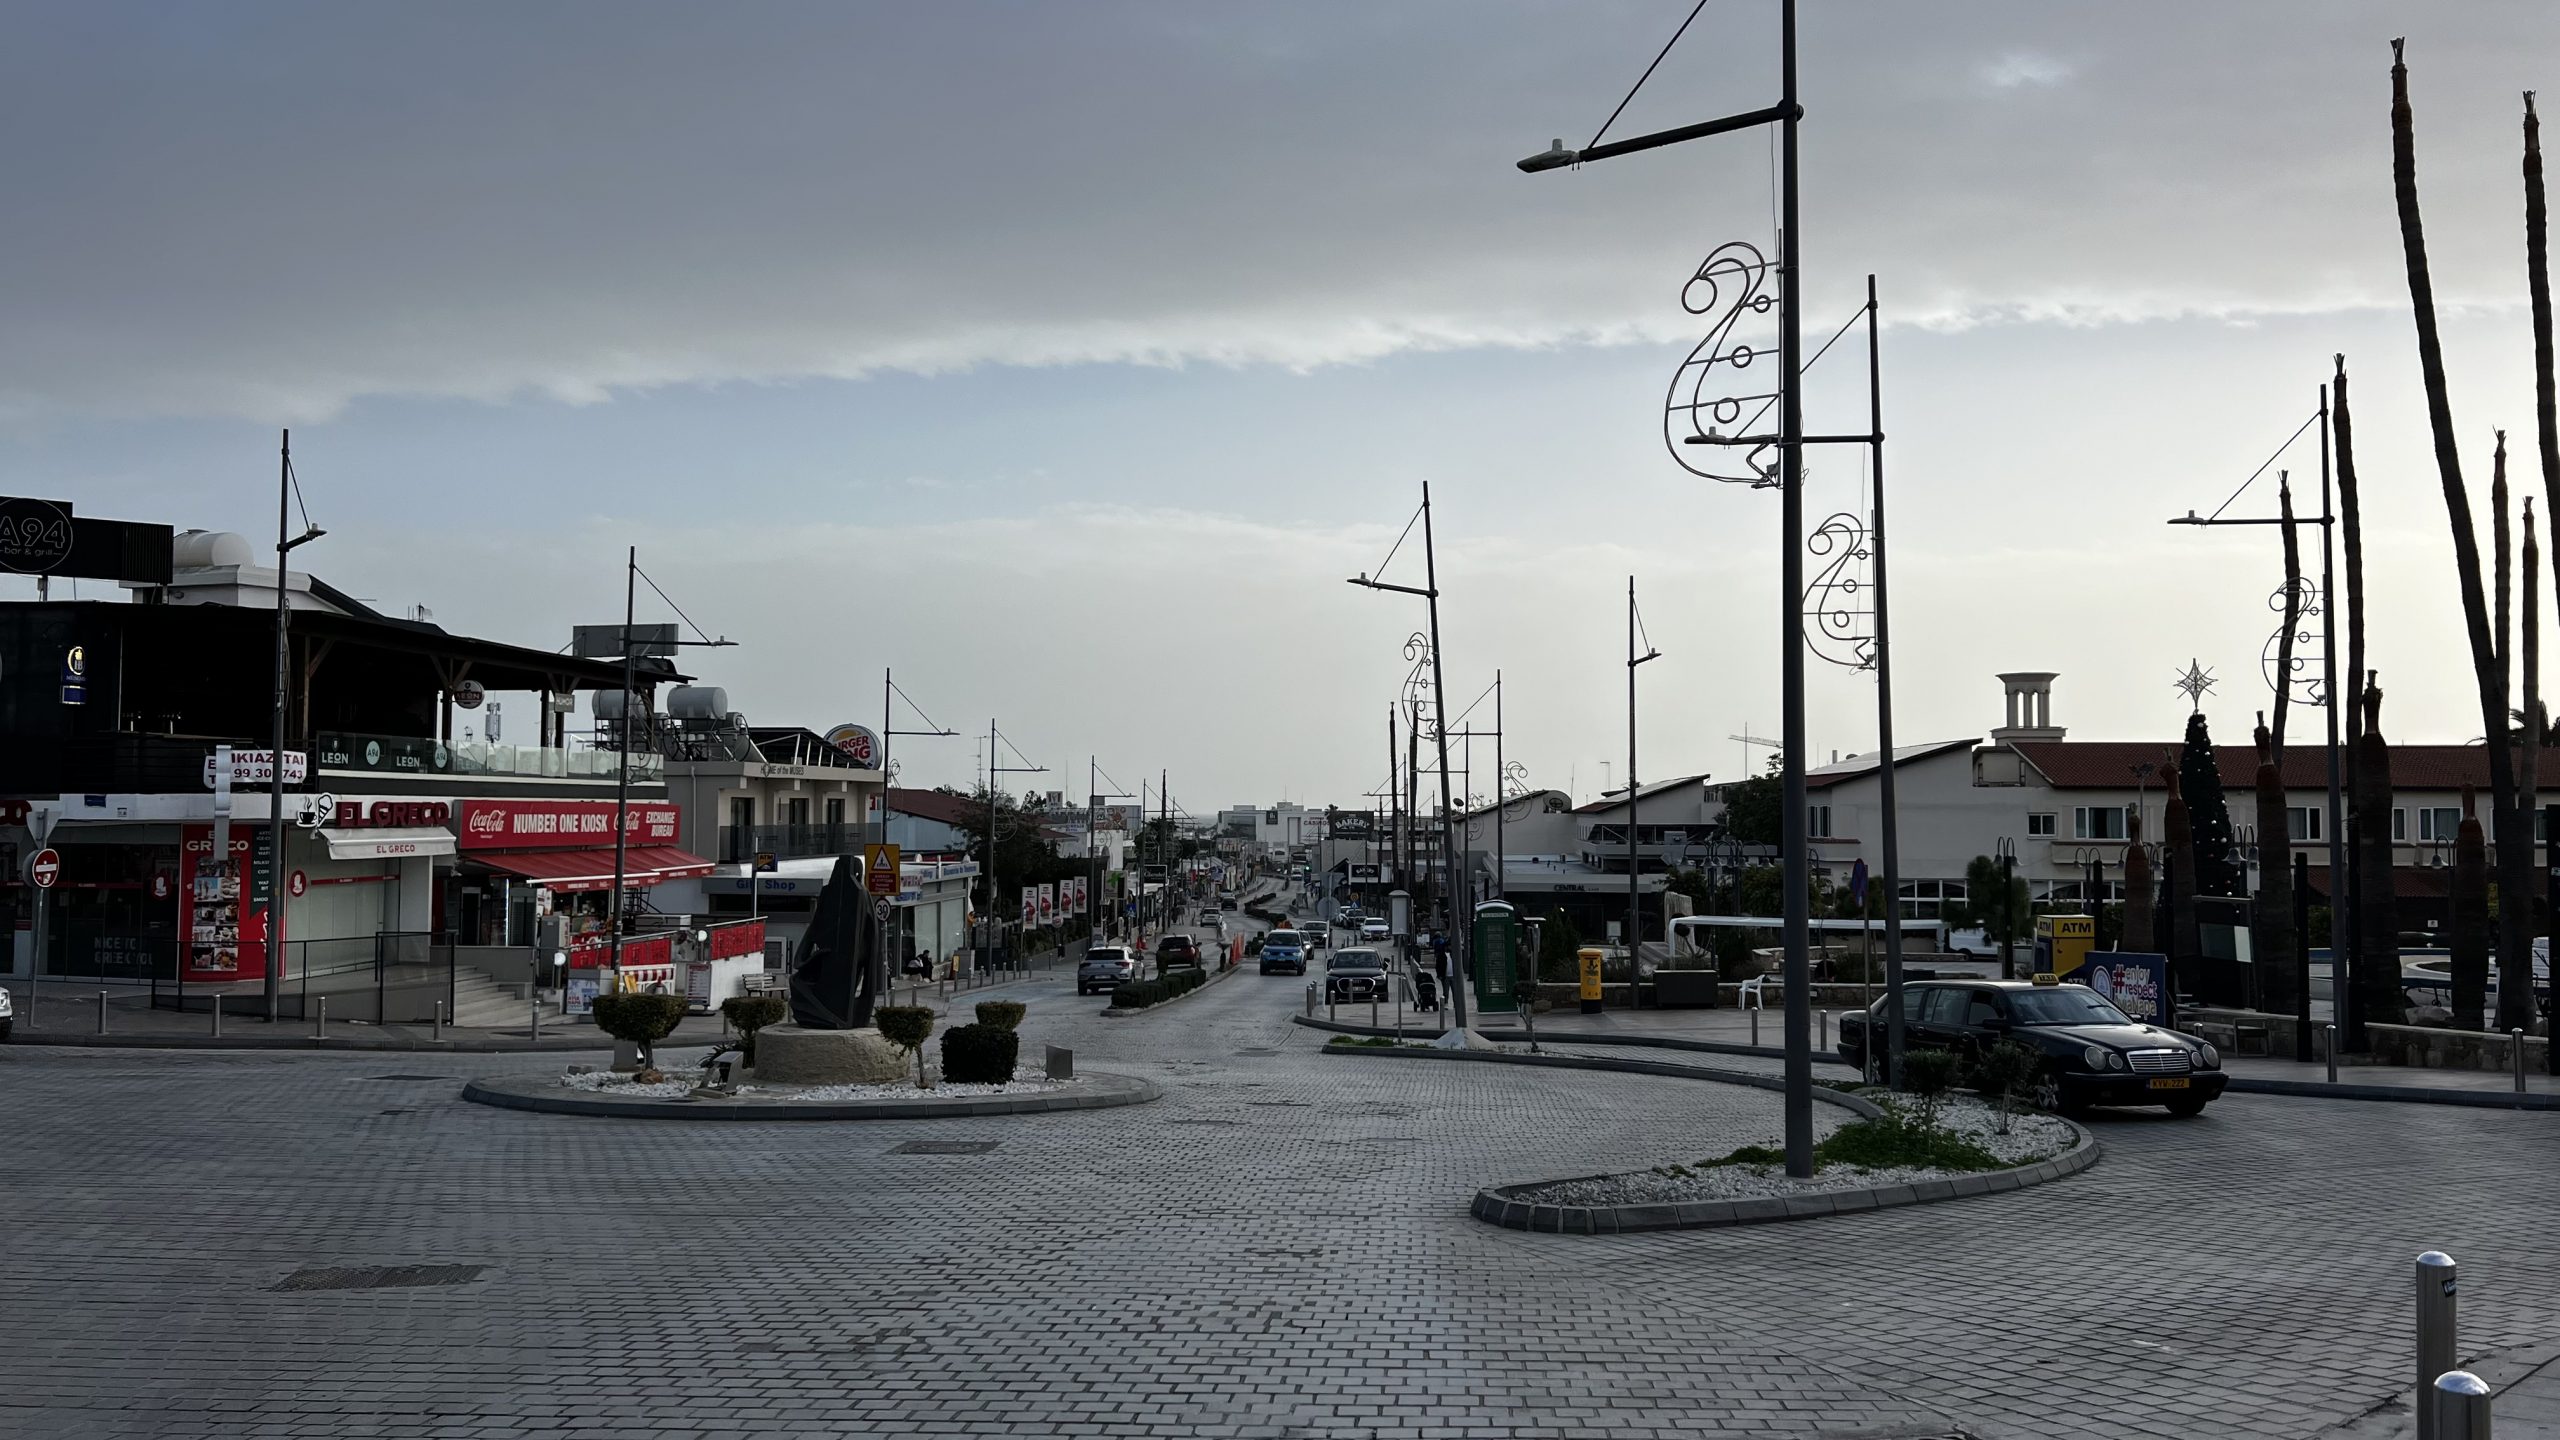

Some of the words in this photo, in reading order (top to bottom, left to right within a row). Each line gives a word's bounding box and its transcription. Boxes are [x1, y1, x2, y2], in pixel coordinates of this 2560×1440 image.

[0, 515, 65, 548] A94
[4, 546, 22, 555] bar
[321, 751, 349, 765] LEON
[367, 748, 379, 757] A94
[396, 755, 420, 768] LEON
[234, 768, 250, 778] 99
[336, 802, 371, 827] EL
[370, 802, 449, 828] GRECO
[646, 811, 676, 824] EXCHANGE
[513, 813, 557, 833] NUMBER
[559, 813, 578, 833] ONE
[580, 812, 608, 833] KIOSK
[1335, 818, 1370, 829] BAKERY
[651, 824, 674, 838] BUREAU
[186, 840, 249, 851] GRCO
[376, 845, 387, 854] EL
[389, 844, 415, 854] GRECO
[765, 879, 796, 891] Shop
[877, 904, 889, 916] 30
[2062, 922, 2091, 933] ATM
[2125, 981, 2158, 999] respect
